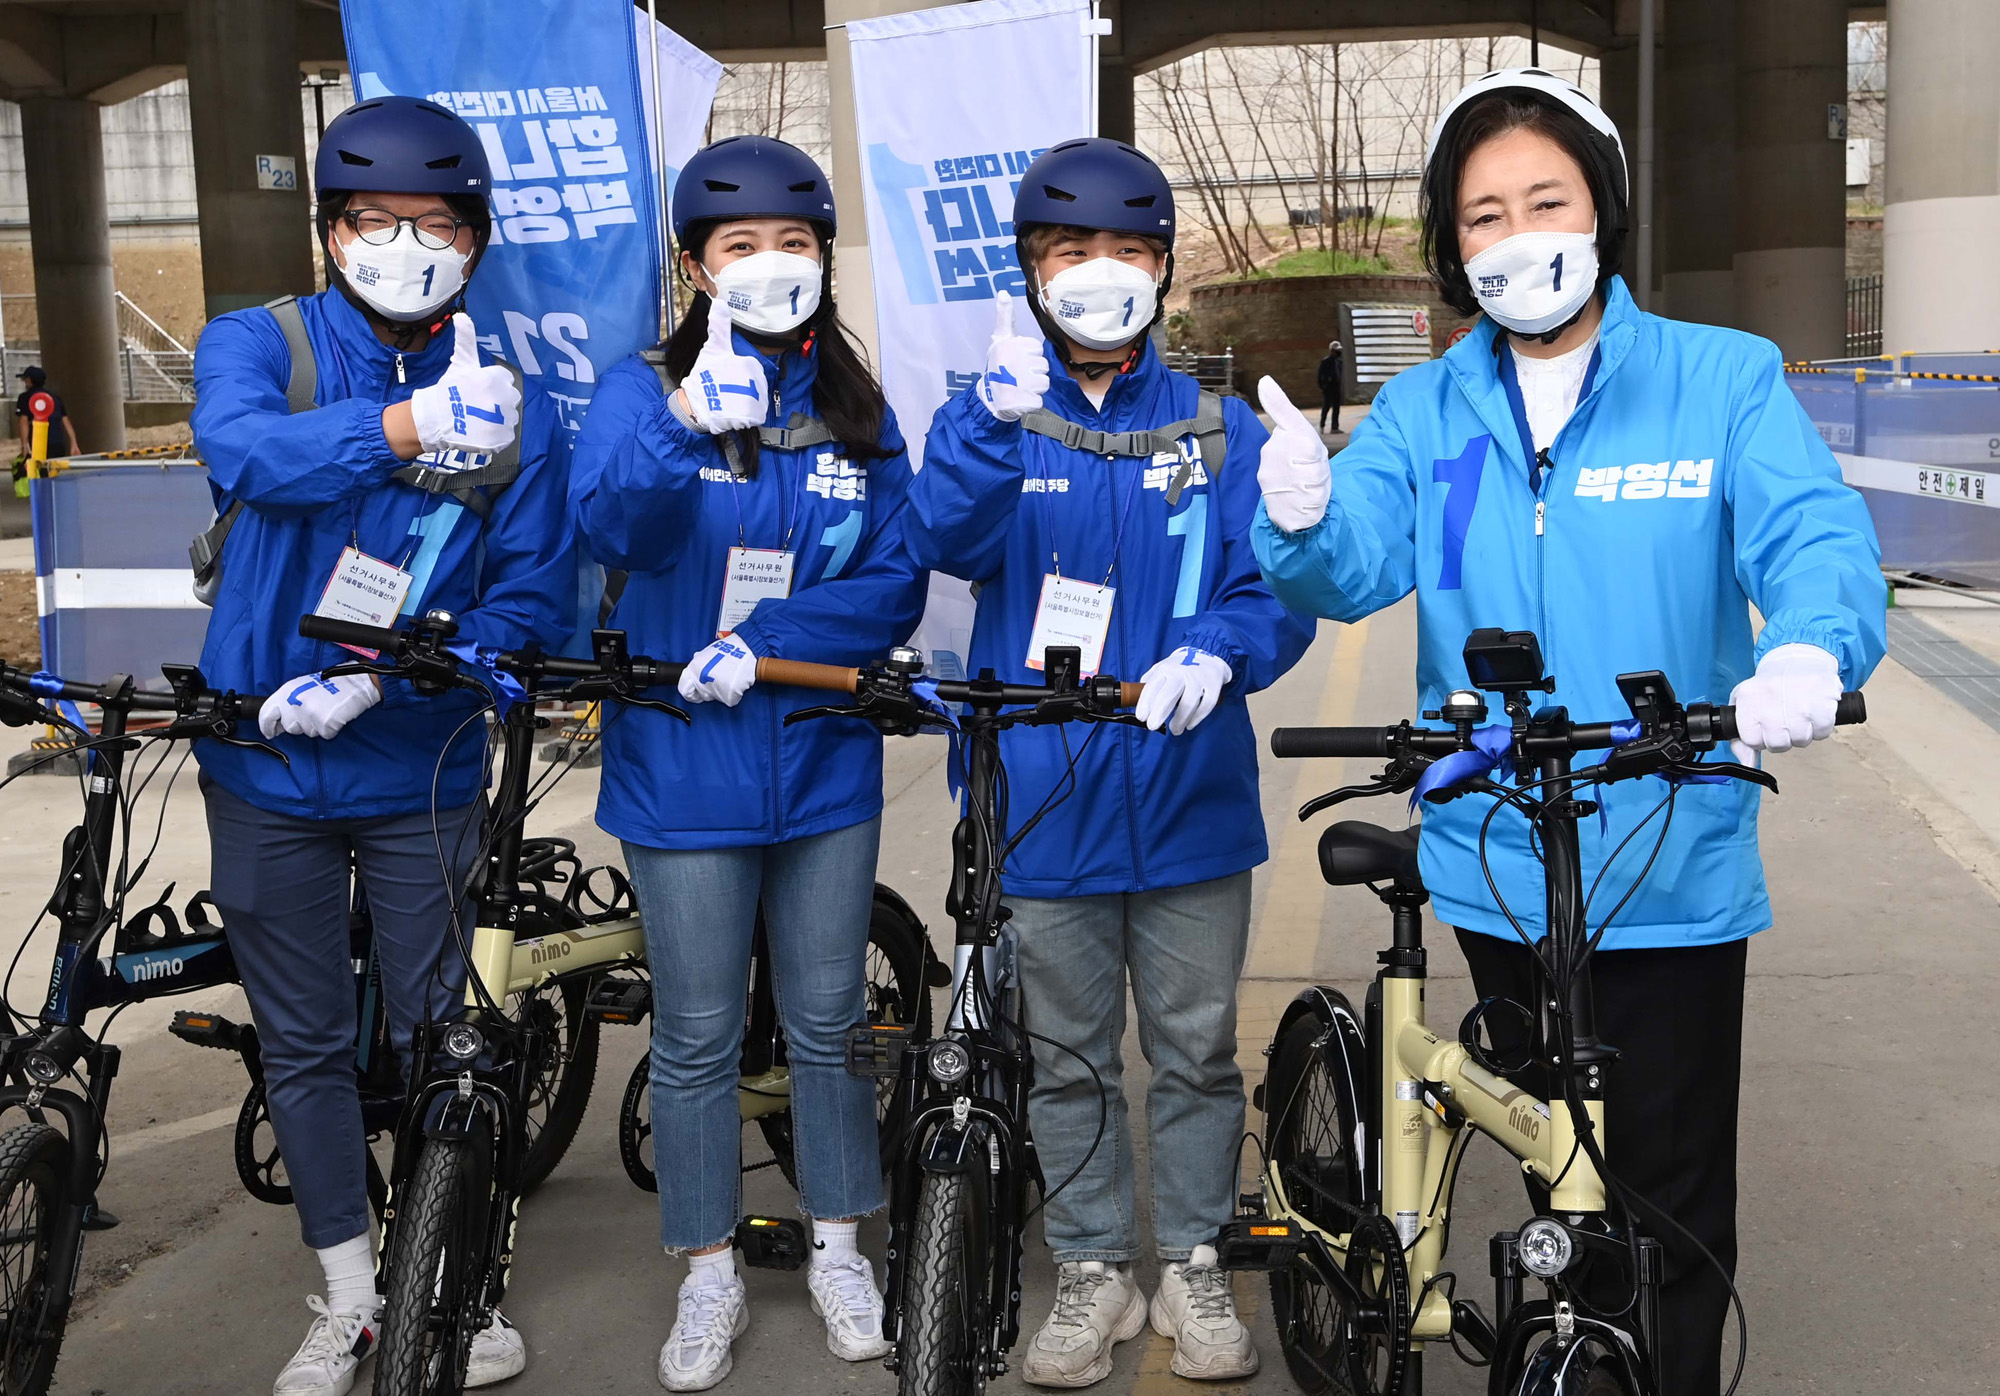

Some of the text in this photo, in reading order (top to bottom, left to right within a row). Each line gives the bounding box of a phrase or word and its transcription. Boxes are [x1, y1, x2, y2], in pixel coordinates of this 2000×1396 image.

[259, 157, 271, 173] R
[272, 169, 294, 188] 23
[422, 264, 435, 297] 1
[1549, 252, 1563, 292] 1
[789, 285, 801, 315] 1
[1122, 296, 1134, 327] 1
[700, 370, 723, 411] 박영선
[719, 378, 759, 401] 1
[988, 365, 1017, 387] 1
[448, 385, 467, 436] 박영선
[465, 403, 505, 425] 1
[1574, 458, 1714, 502] 박영선
[1919, 471, 1985, 500] 안전 제일
[1433, 433, 1491, 590] 1
[404, 502, 464, 615] 1
[820, 510, 863, 580] 1
[1167, 494, 1208, 618] 1
[699, 652, 725, 684] 1
[286, 681, 318, 706] 1
[531, 941, 571, 964] nimo
[132, 956, 184, 983] nimo
[1508, 1105, 1540, 1142] nimo
